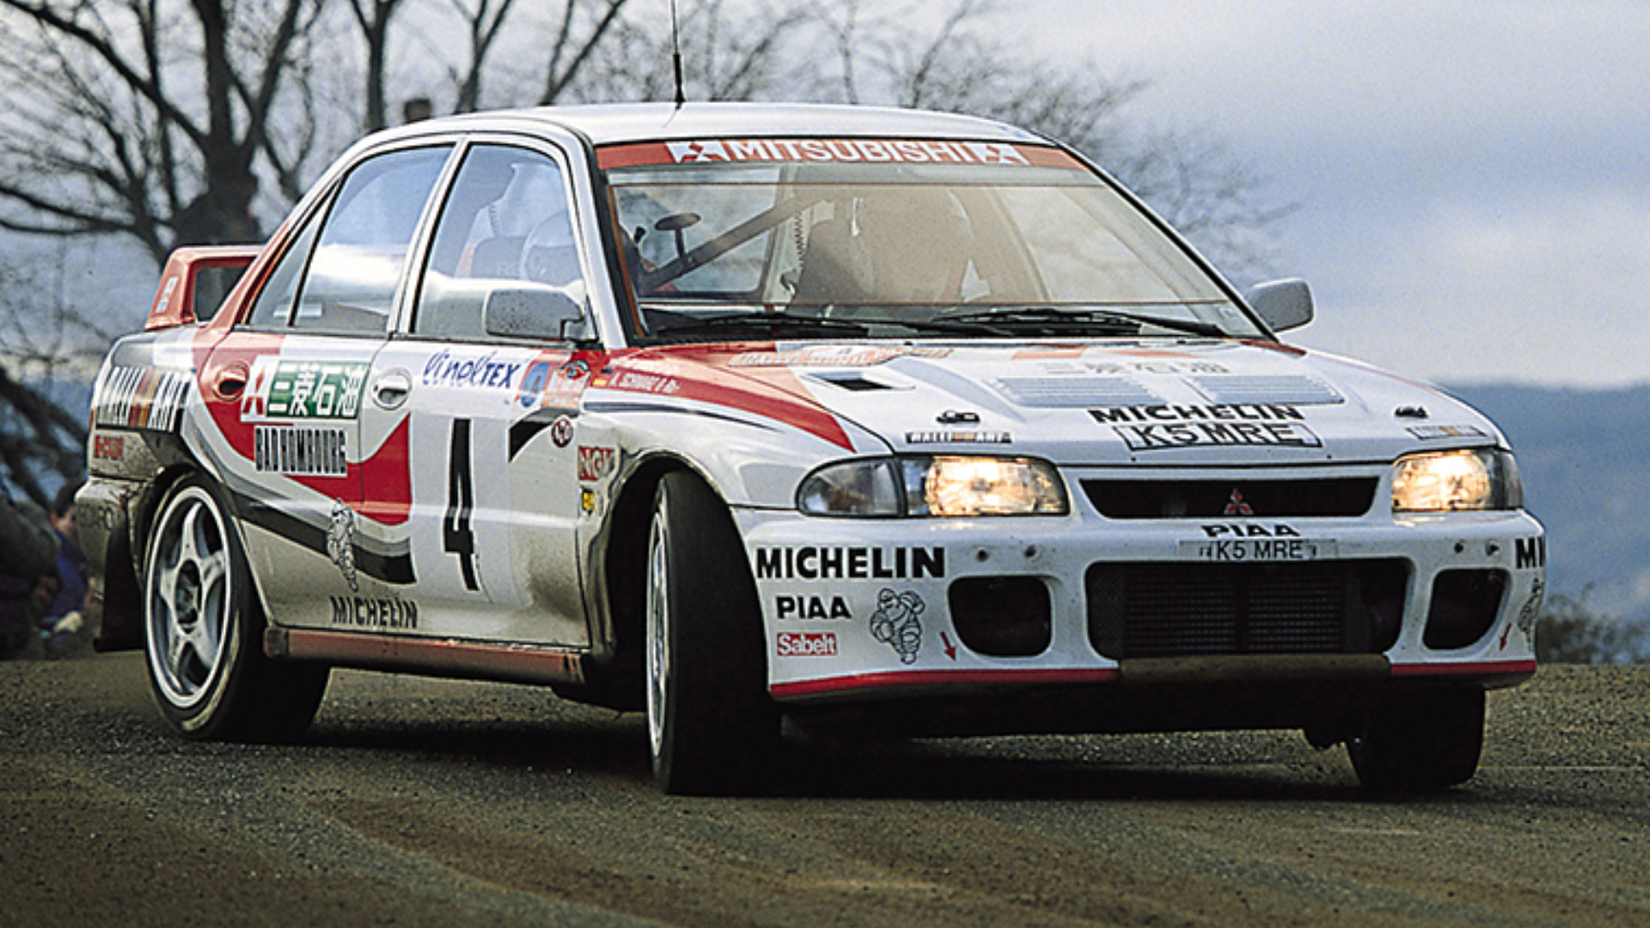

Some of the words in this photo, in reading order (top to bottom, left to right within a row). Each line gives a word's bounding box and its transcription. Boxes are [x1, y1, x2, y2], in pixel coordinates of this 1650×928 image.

[730, 140, 976, 164] MITSUBISHI
[268, 361, 366, 418] 三菱石油
[1087, 403, 1306, 423] MICHELIN
[1131, 424, 1203, 446] K5
[1208, 423, 1304, 445] MRE
[443, 418, 480, 592] 4
[1201, 524, 1301, 538] PIAA
[1216, 540, 1246, 559] K5
[1254, 540, 1304, 559] MRE
[757, 546, 946, 579] MICHELIN
[329, 596, 418, 629] MICHELIN
[776, 596, 852, 619] PIAA
[777, 634, 837, 655] Sabelt
